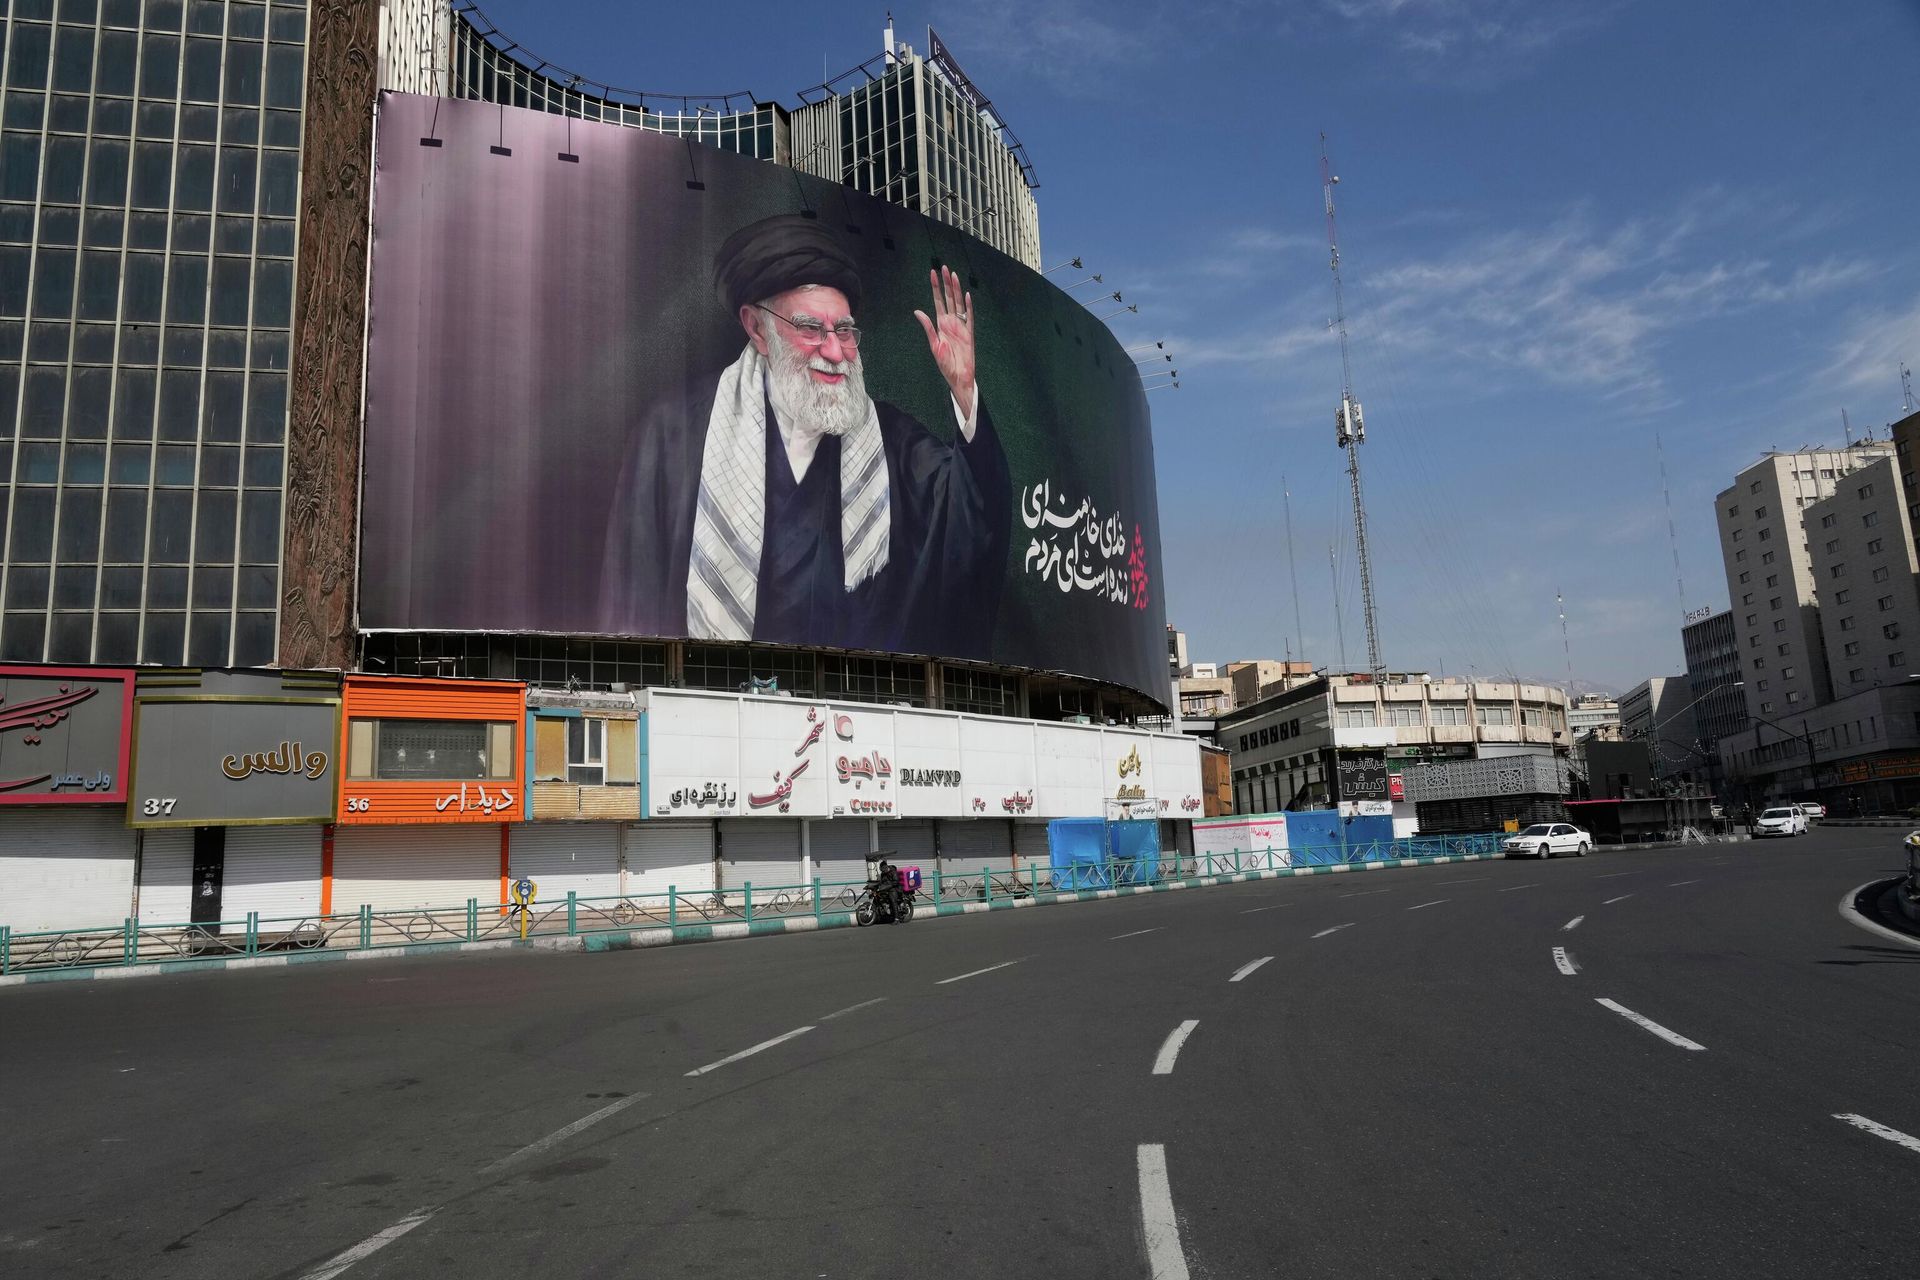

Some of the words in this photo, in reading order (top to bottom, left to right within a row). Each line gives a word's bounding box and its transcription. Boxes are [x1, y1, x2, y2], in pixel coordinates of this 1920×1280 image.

[221, 741, 329, 779] والس
[1340, 756, 1363, 773] خرید
[1363, 756, 1385, 771] مرکز
[51, 774, 83, 792] عصر
[748, 759, 810, 813] کیف
[1343, 772, 1386, 797] کیش
[143, 798, 177, 815] 37
[347, 798, 370, 811] 36
[436, 782, 514, 814] دیدار
